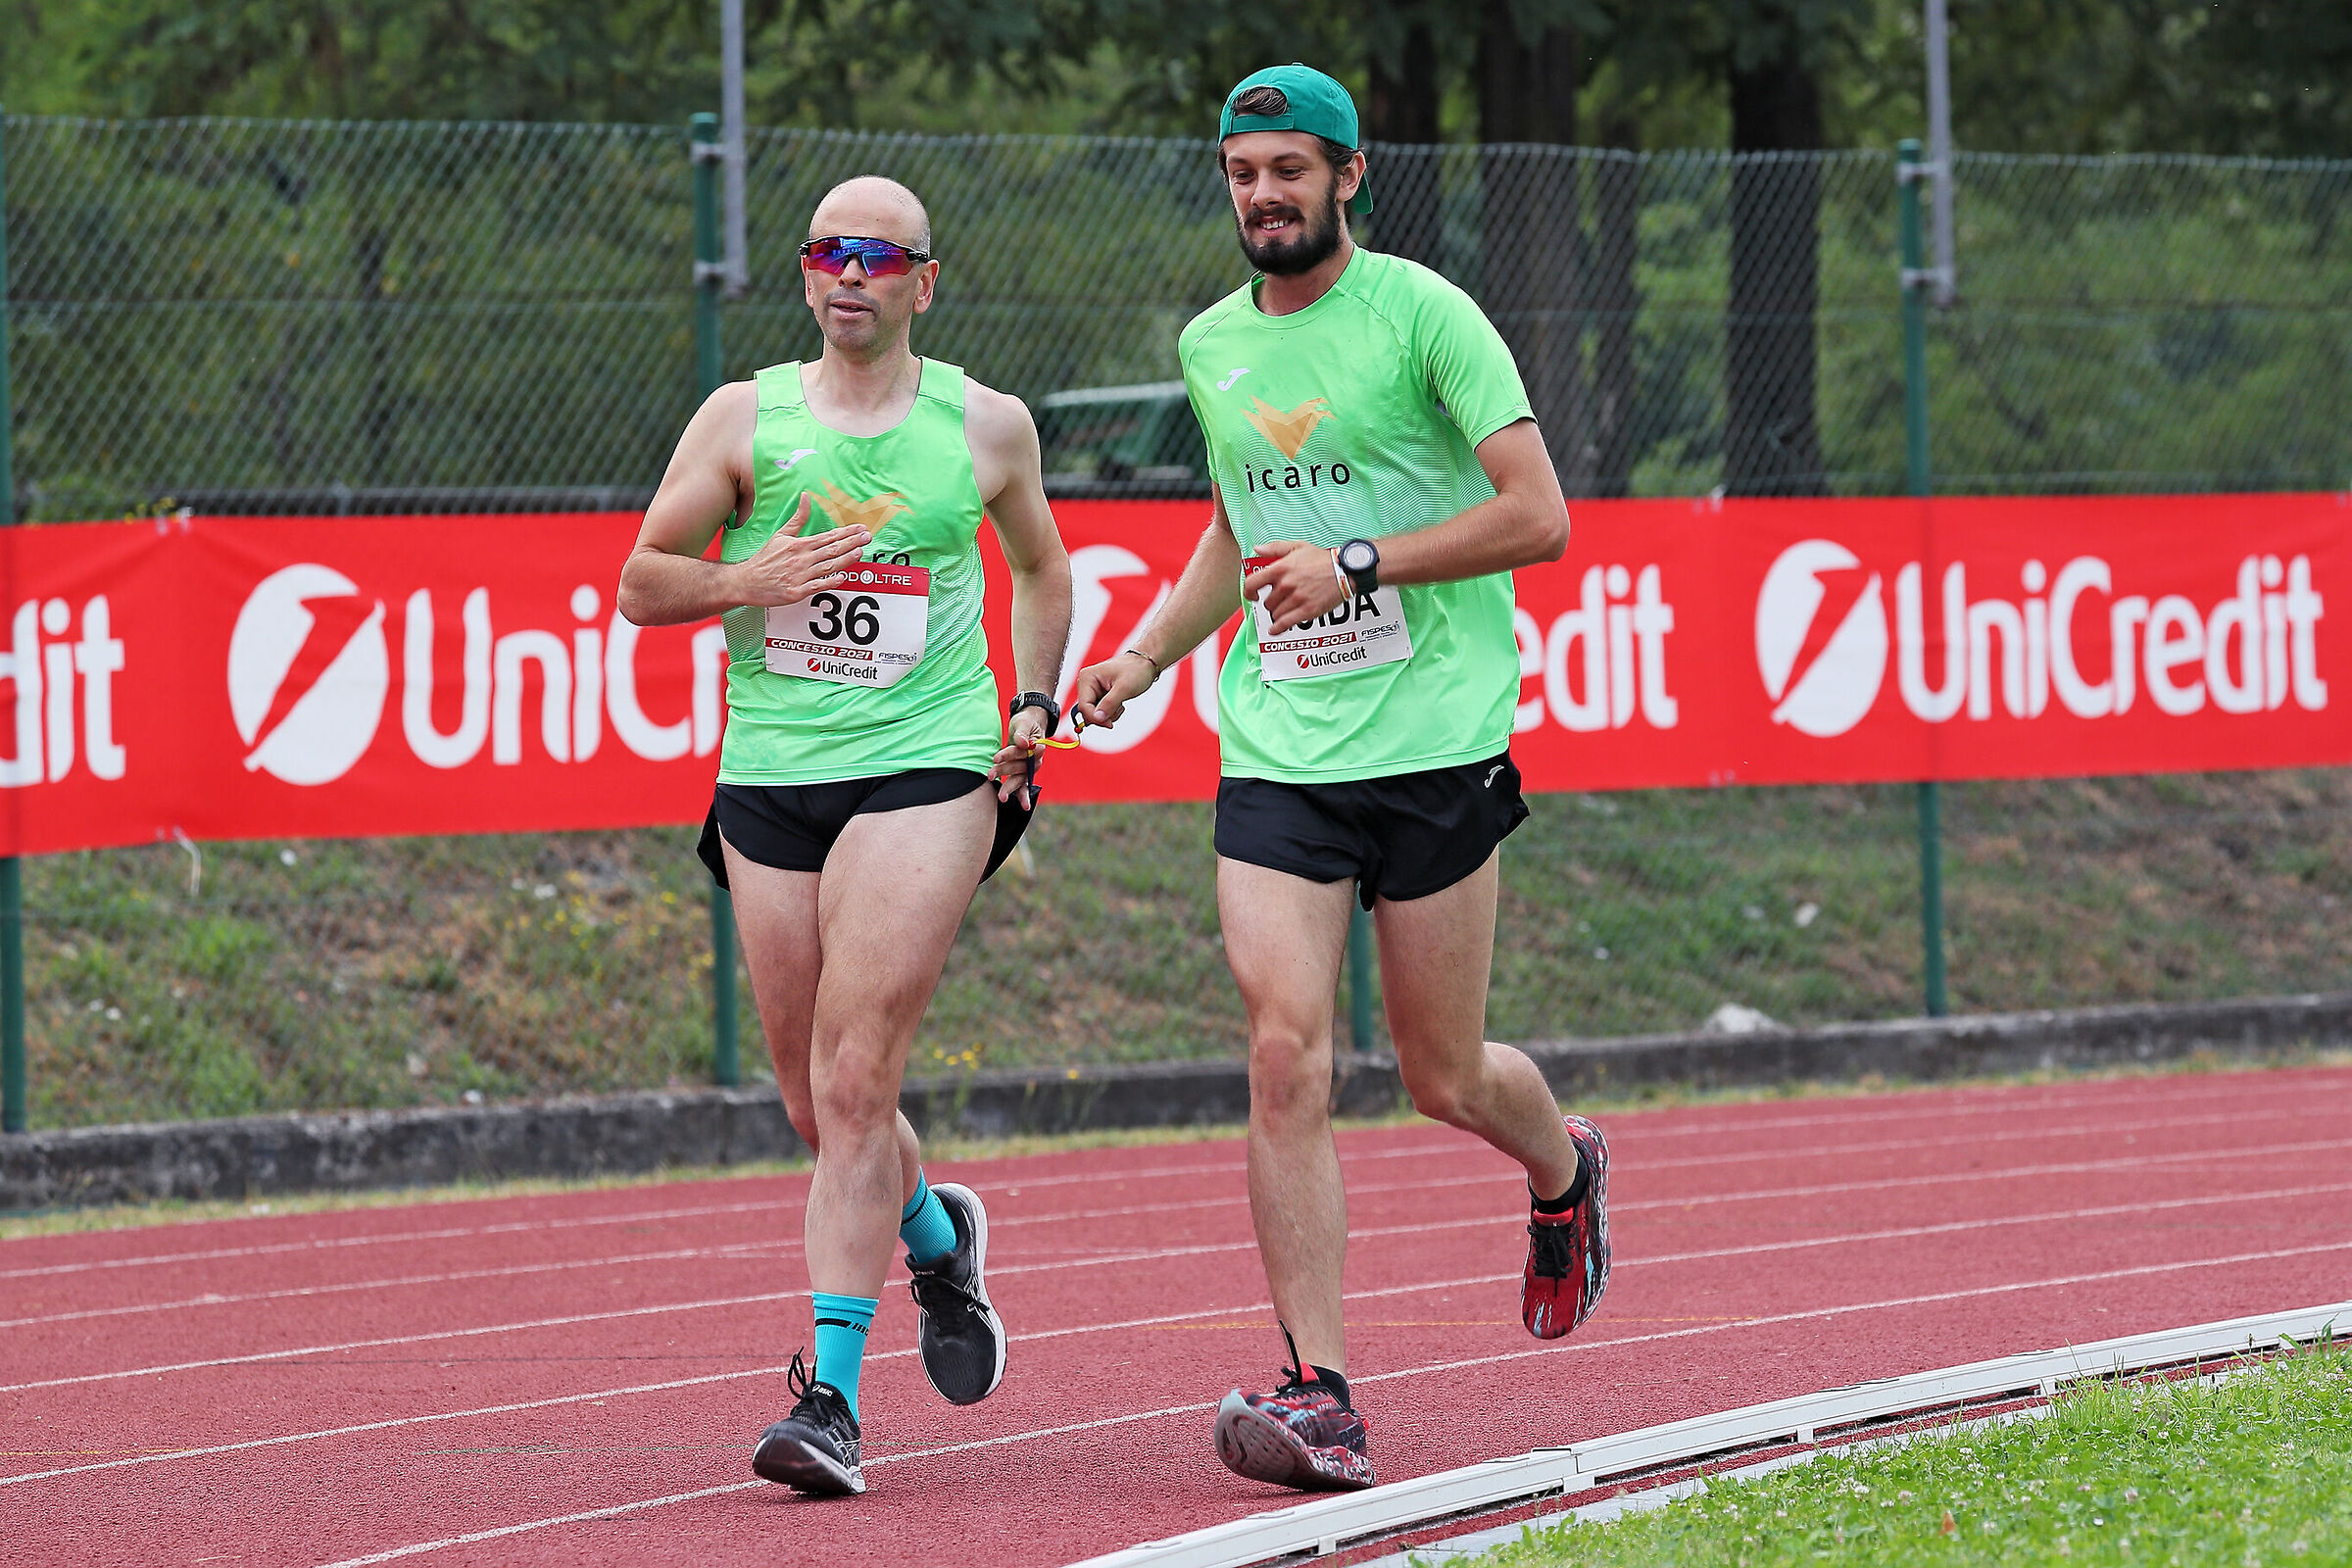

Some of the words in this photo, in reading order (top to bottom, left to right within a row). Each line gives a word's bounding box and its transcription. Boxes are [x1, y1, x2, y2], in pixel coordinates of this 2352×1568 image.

[1246, 463, 1350, 493] icaro
[808, 593, 880, 646] 36
[1263, 639, 1319, 653] CONCESIO
[1321, 632, 1353, 645] 2021
[1894, 554, 2328, 723] UniCredit
[771, 640, 836, 656] CONCESIO
[837, 648, 871, 660] 2021
[1310, 646, 1368, 668] UniCredit
[822, 662, 878, 680] UniCredit
